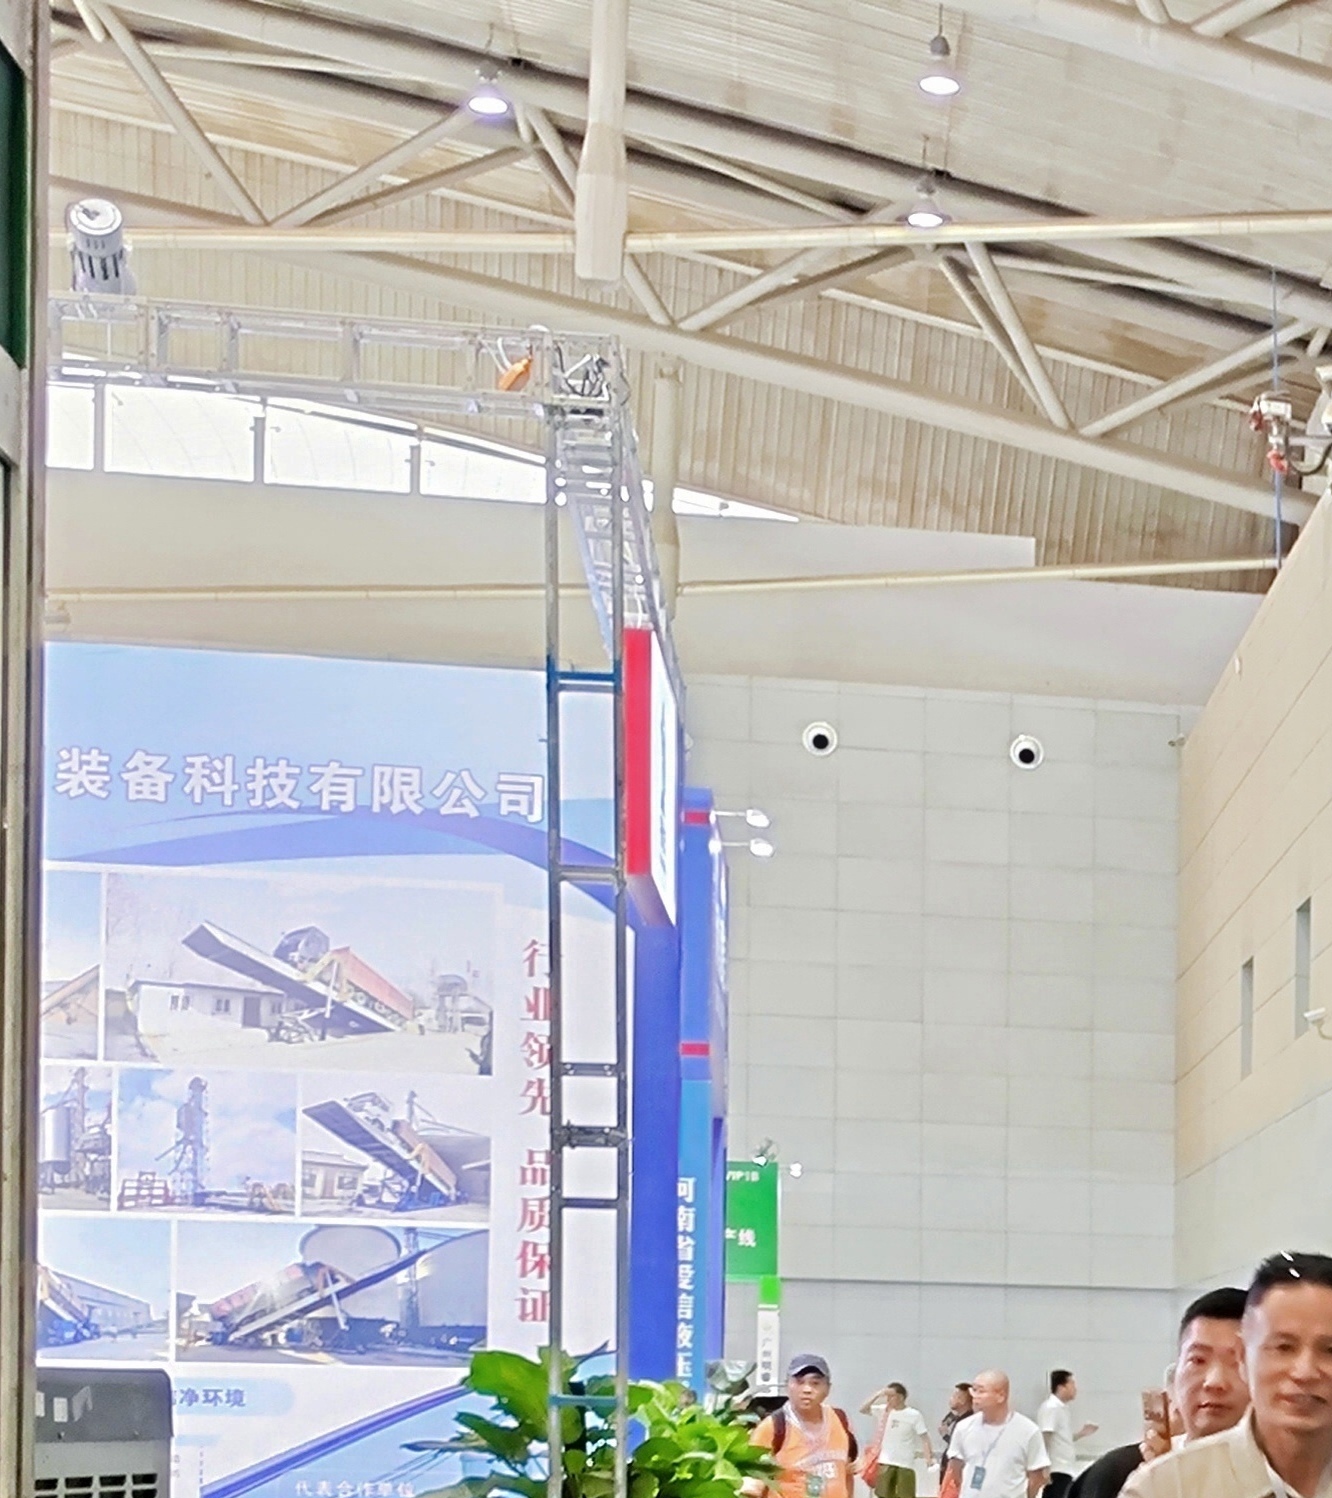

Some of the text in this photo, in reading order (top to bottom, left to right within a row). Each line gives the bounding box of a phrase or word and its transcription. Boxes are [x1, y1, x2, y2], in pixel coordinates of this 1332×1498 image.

[55, 746, 545, 824] 装备科技有限公司
[514, 1149, 554, 1323] 品质保证
[171, 1387, 247, 1408] 净环境
